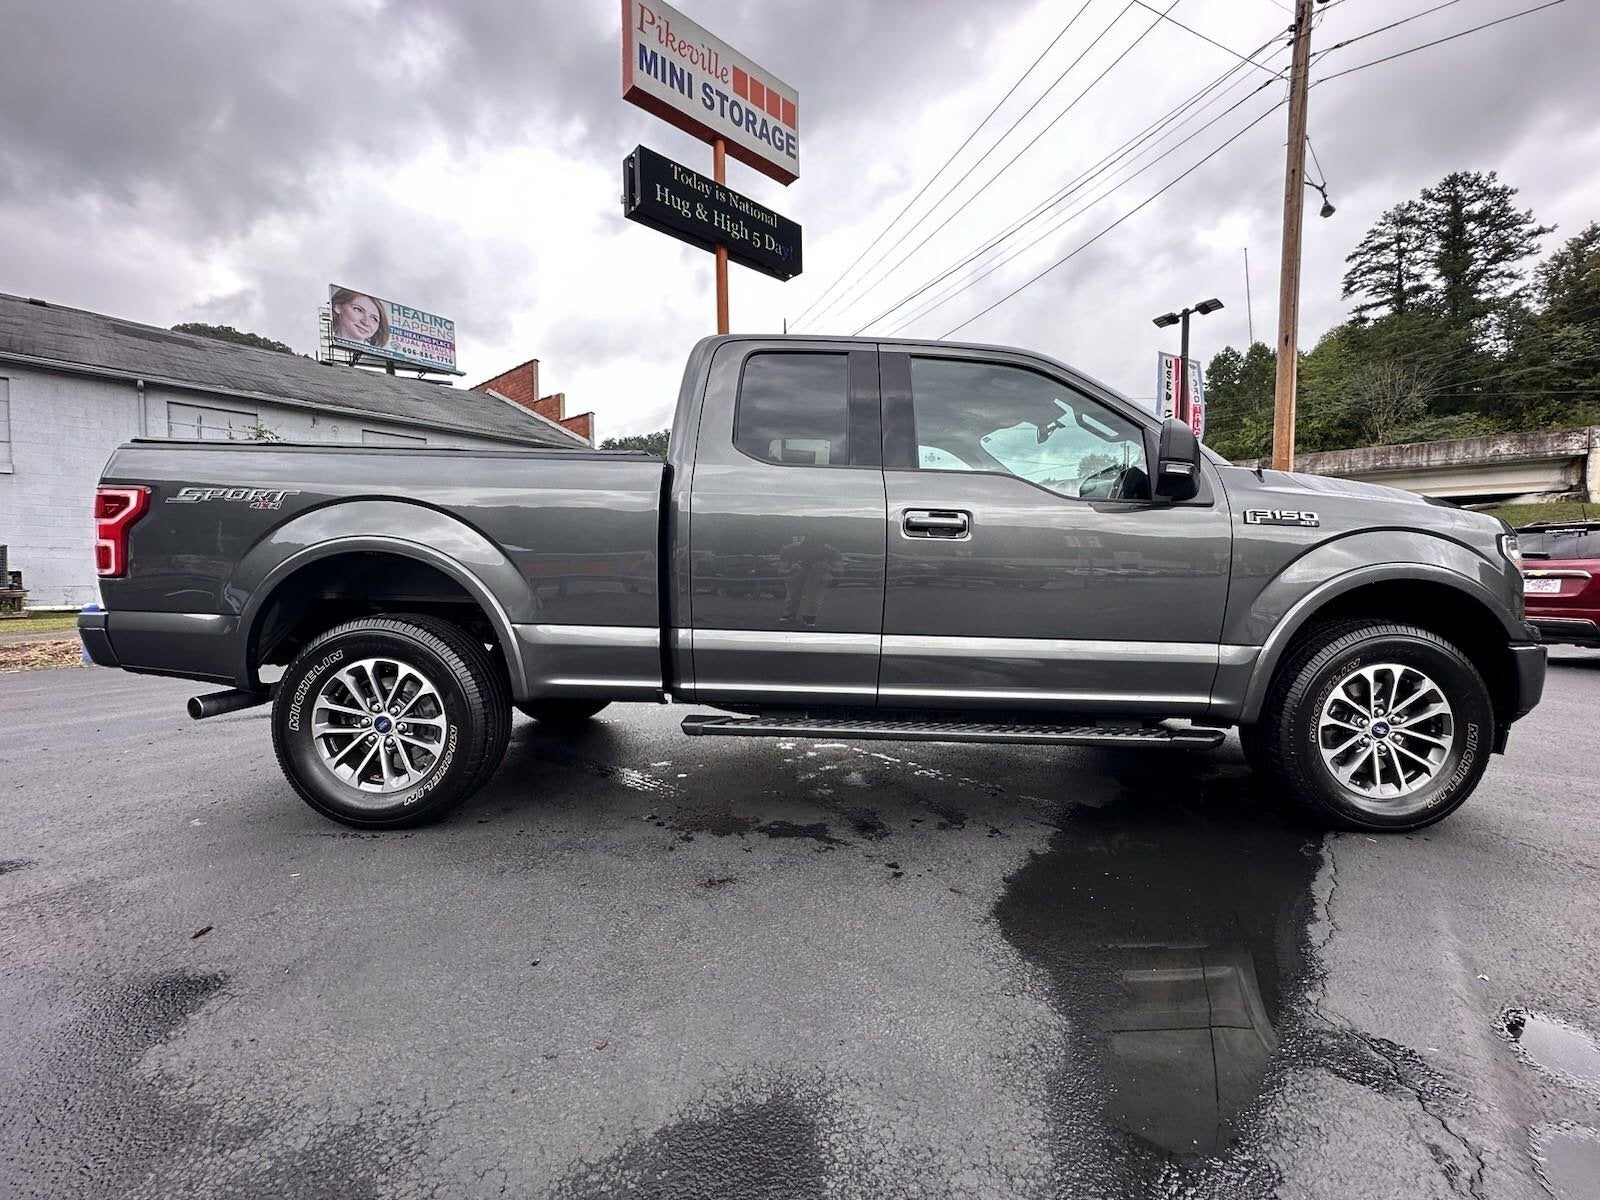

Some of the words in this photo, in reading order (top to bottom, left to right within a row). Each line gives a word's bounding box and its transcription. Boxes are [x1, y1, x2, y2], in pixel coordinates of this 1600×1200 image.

[637, 2, 729, 85] Pikeville
[639, 42, 693, 100] MINI
[701, 82, 797, 160] STORAGE
[656, 183, 692, 218] Hug
[695, 203, 709, 223] &
[713, 209, 749, 240] High
[752, 233, 761, 248] 5
[670, 163, 713, 199] Today
[715, 185, 726, 202] is
[729, 192, 778, 228] National
[391, 303, 453, 331] HEALING
[391, 315, 454, 342] HAPPENS
[391, 328, 402, 337] THE
[405, 332, 431, 343] HEALING
[432, 338, 450, 348] PLACE
[391, 335, 420, 347] SEXUAL
[421, 342, 452, 355] ASSAULT
[1165, 359, 1173, 401] USED
[165, 487, 301, 504] SPORT
[289, 649, 344, 731] MICHELIN
[1309, 658, 1361, 743] MICHELIN
[403, 724, 458, 806] MICHELIN
[1426, 723, 1479, 809] MICHELIN
